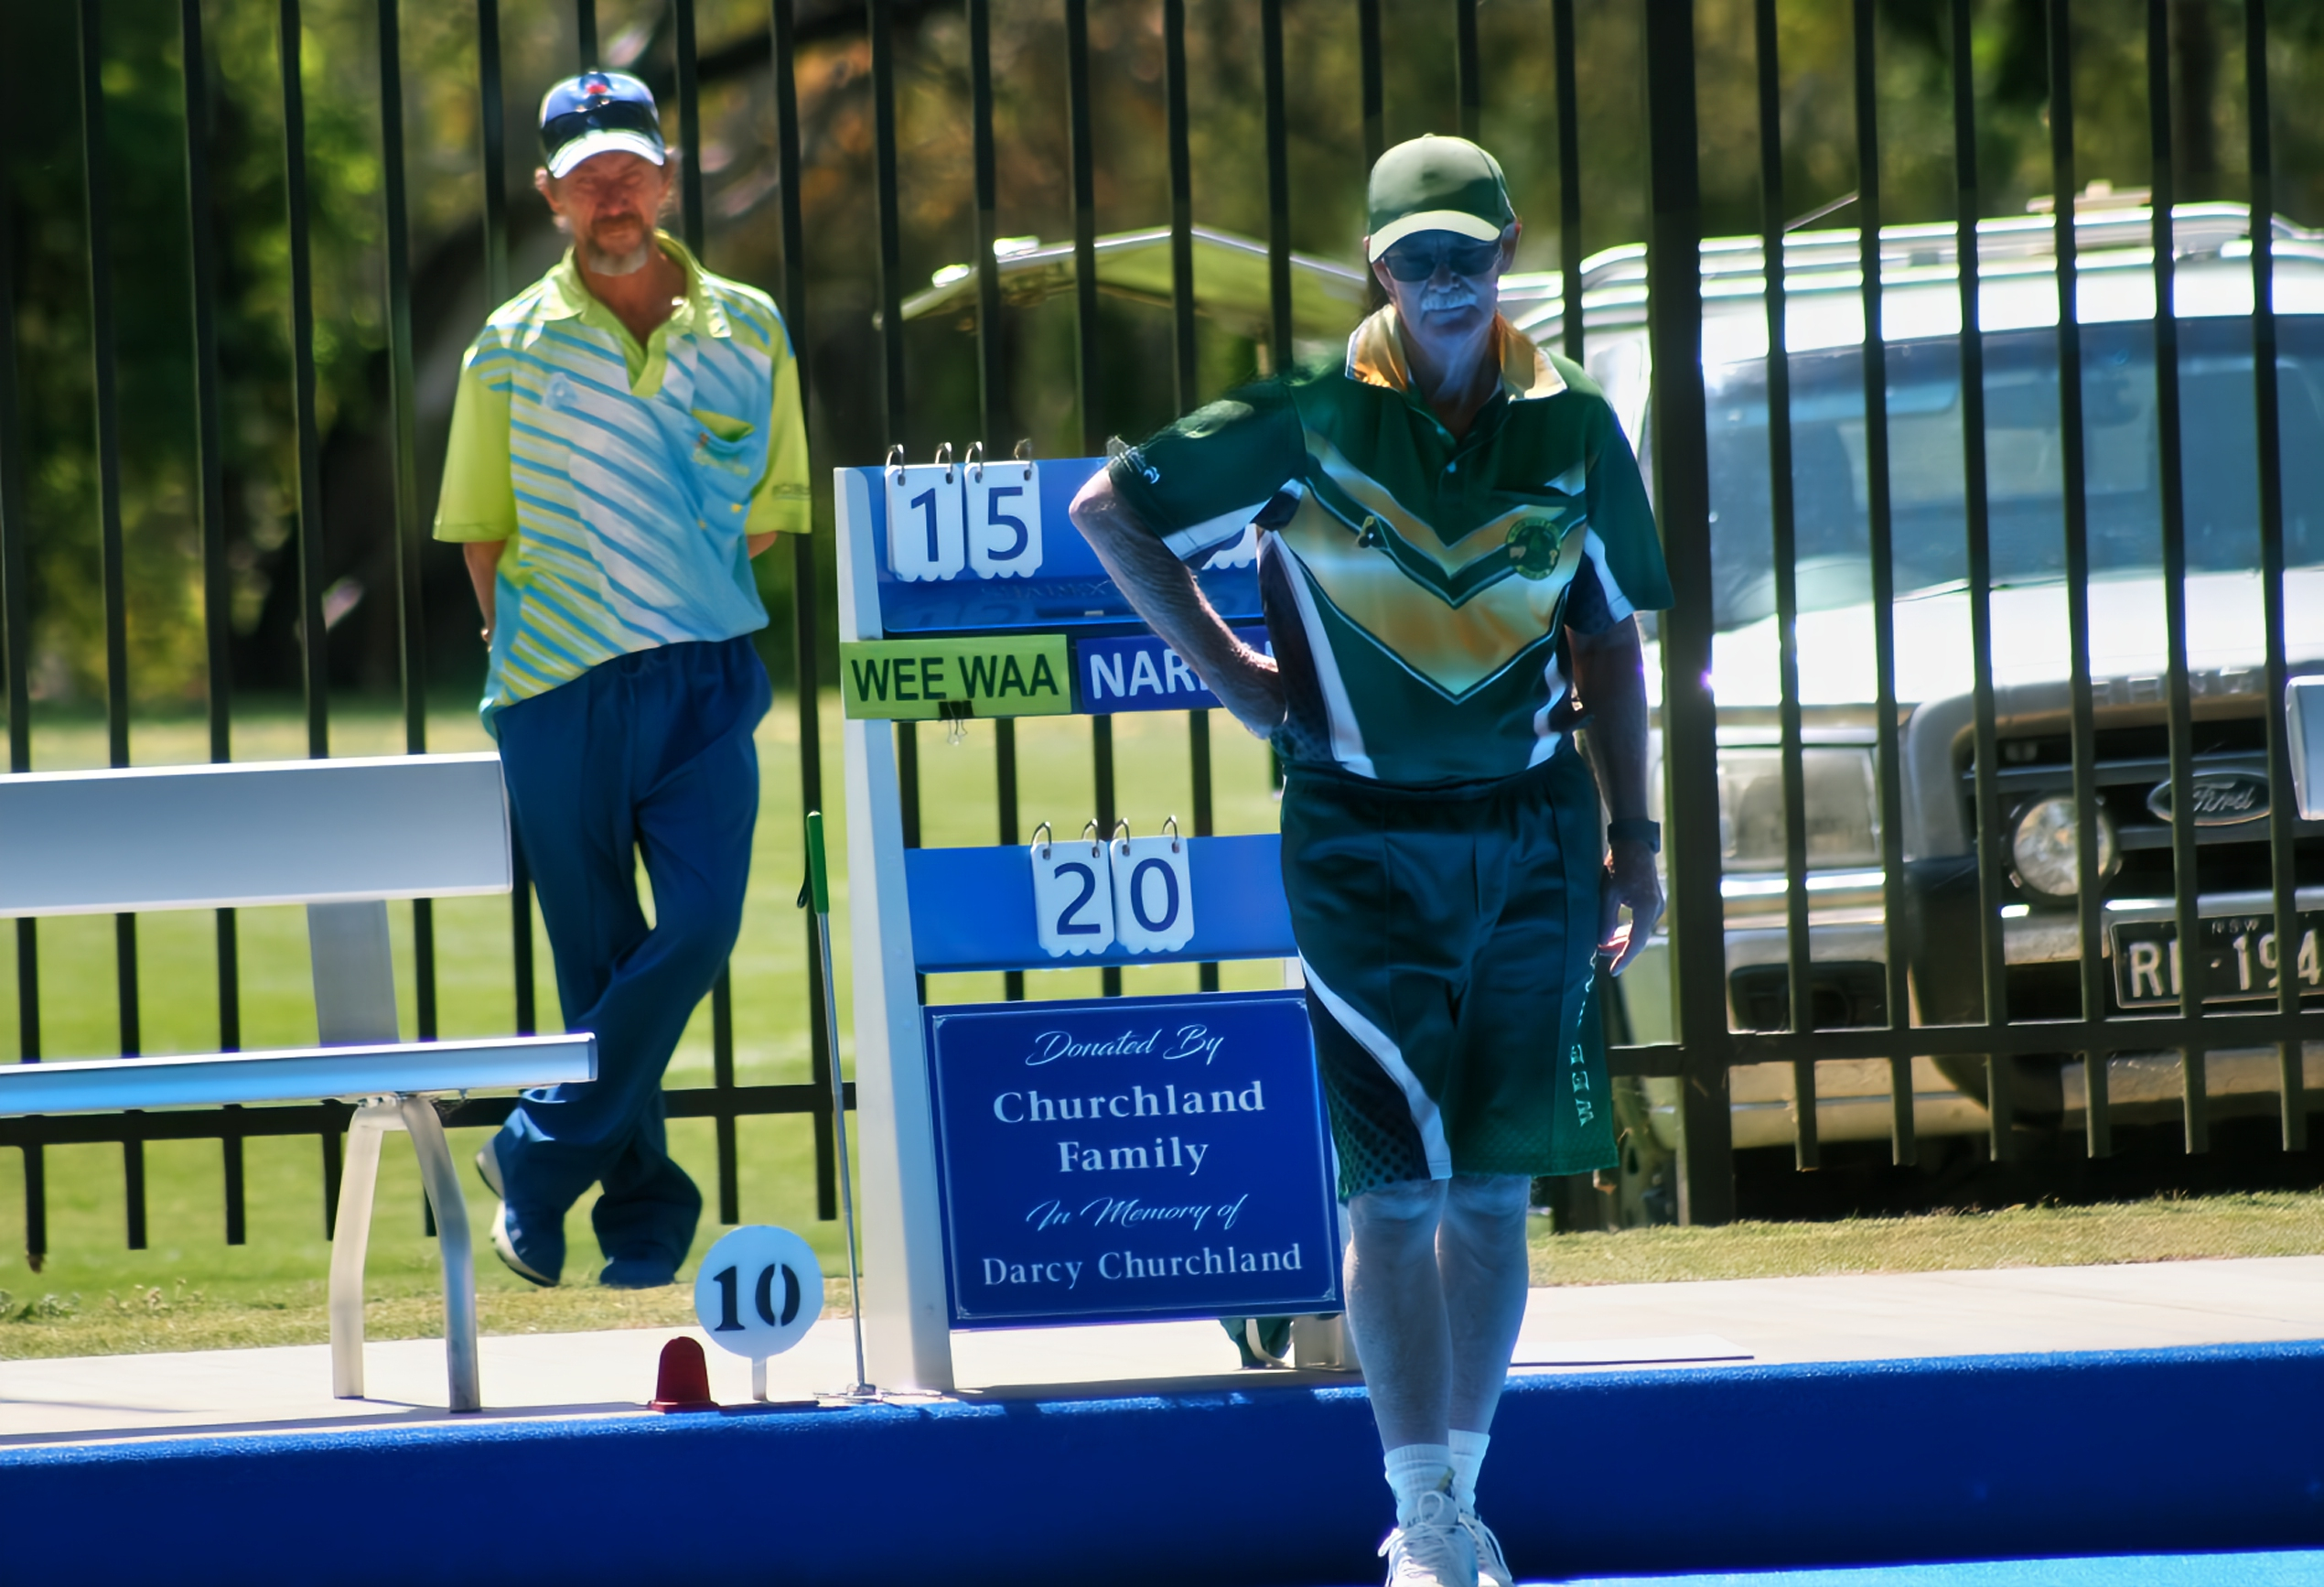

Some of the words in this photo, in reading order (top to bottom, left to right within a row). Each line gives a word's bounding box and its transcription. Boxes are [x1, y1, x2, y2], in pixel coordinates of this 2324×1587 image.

[910, 486, 1029, 563] 15
[850, 656, 947, 703] WEE
[957, 653, 1060, 698] WAA
[1054, 857, 1180, 935] 20
[1025, 1029, 1164, 1066] Donated
[1163, 1023, 1225, 1065] By
[993, 1080, 1265, 1124] Churchland
[1058, 1137, 1210, 1176] Family
[1026, 1199, 1072, 1232] In
[1080, 1195, 1211, 1231] Memory
[1210, 1193, 1250, 1230] of
[983, 1257, 1083, 1289] Darcy
[1098, 1244, 1303, 1279] Churchland
[713, 1263, 802, 1332] 10
